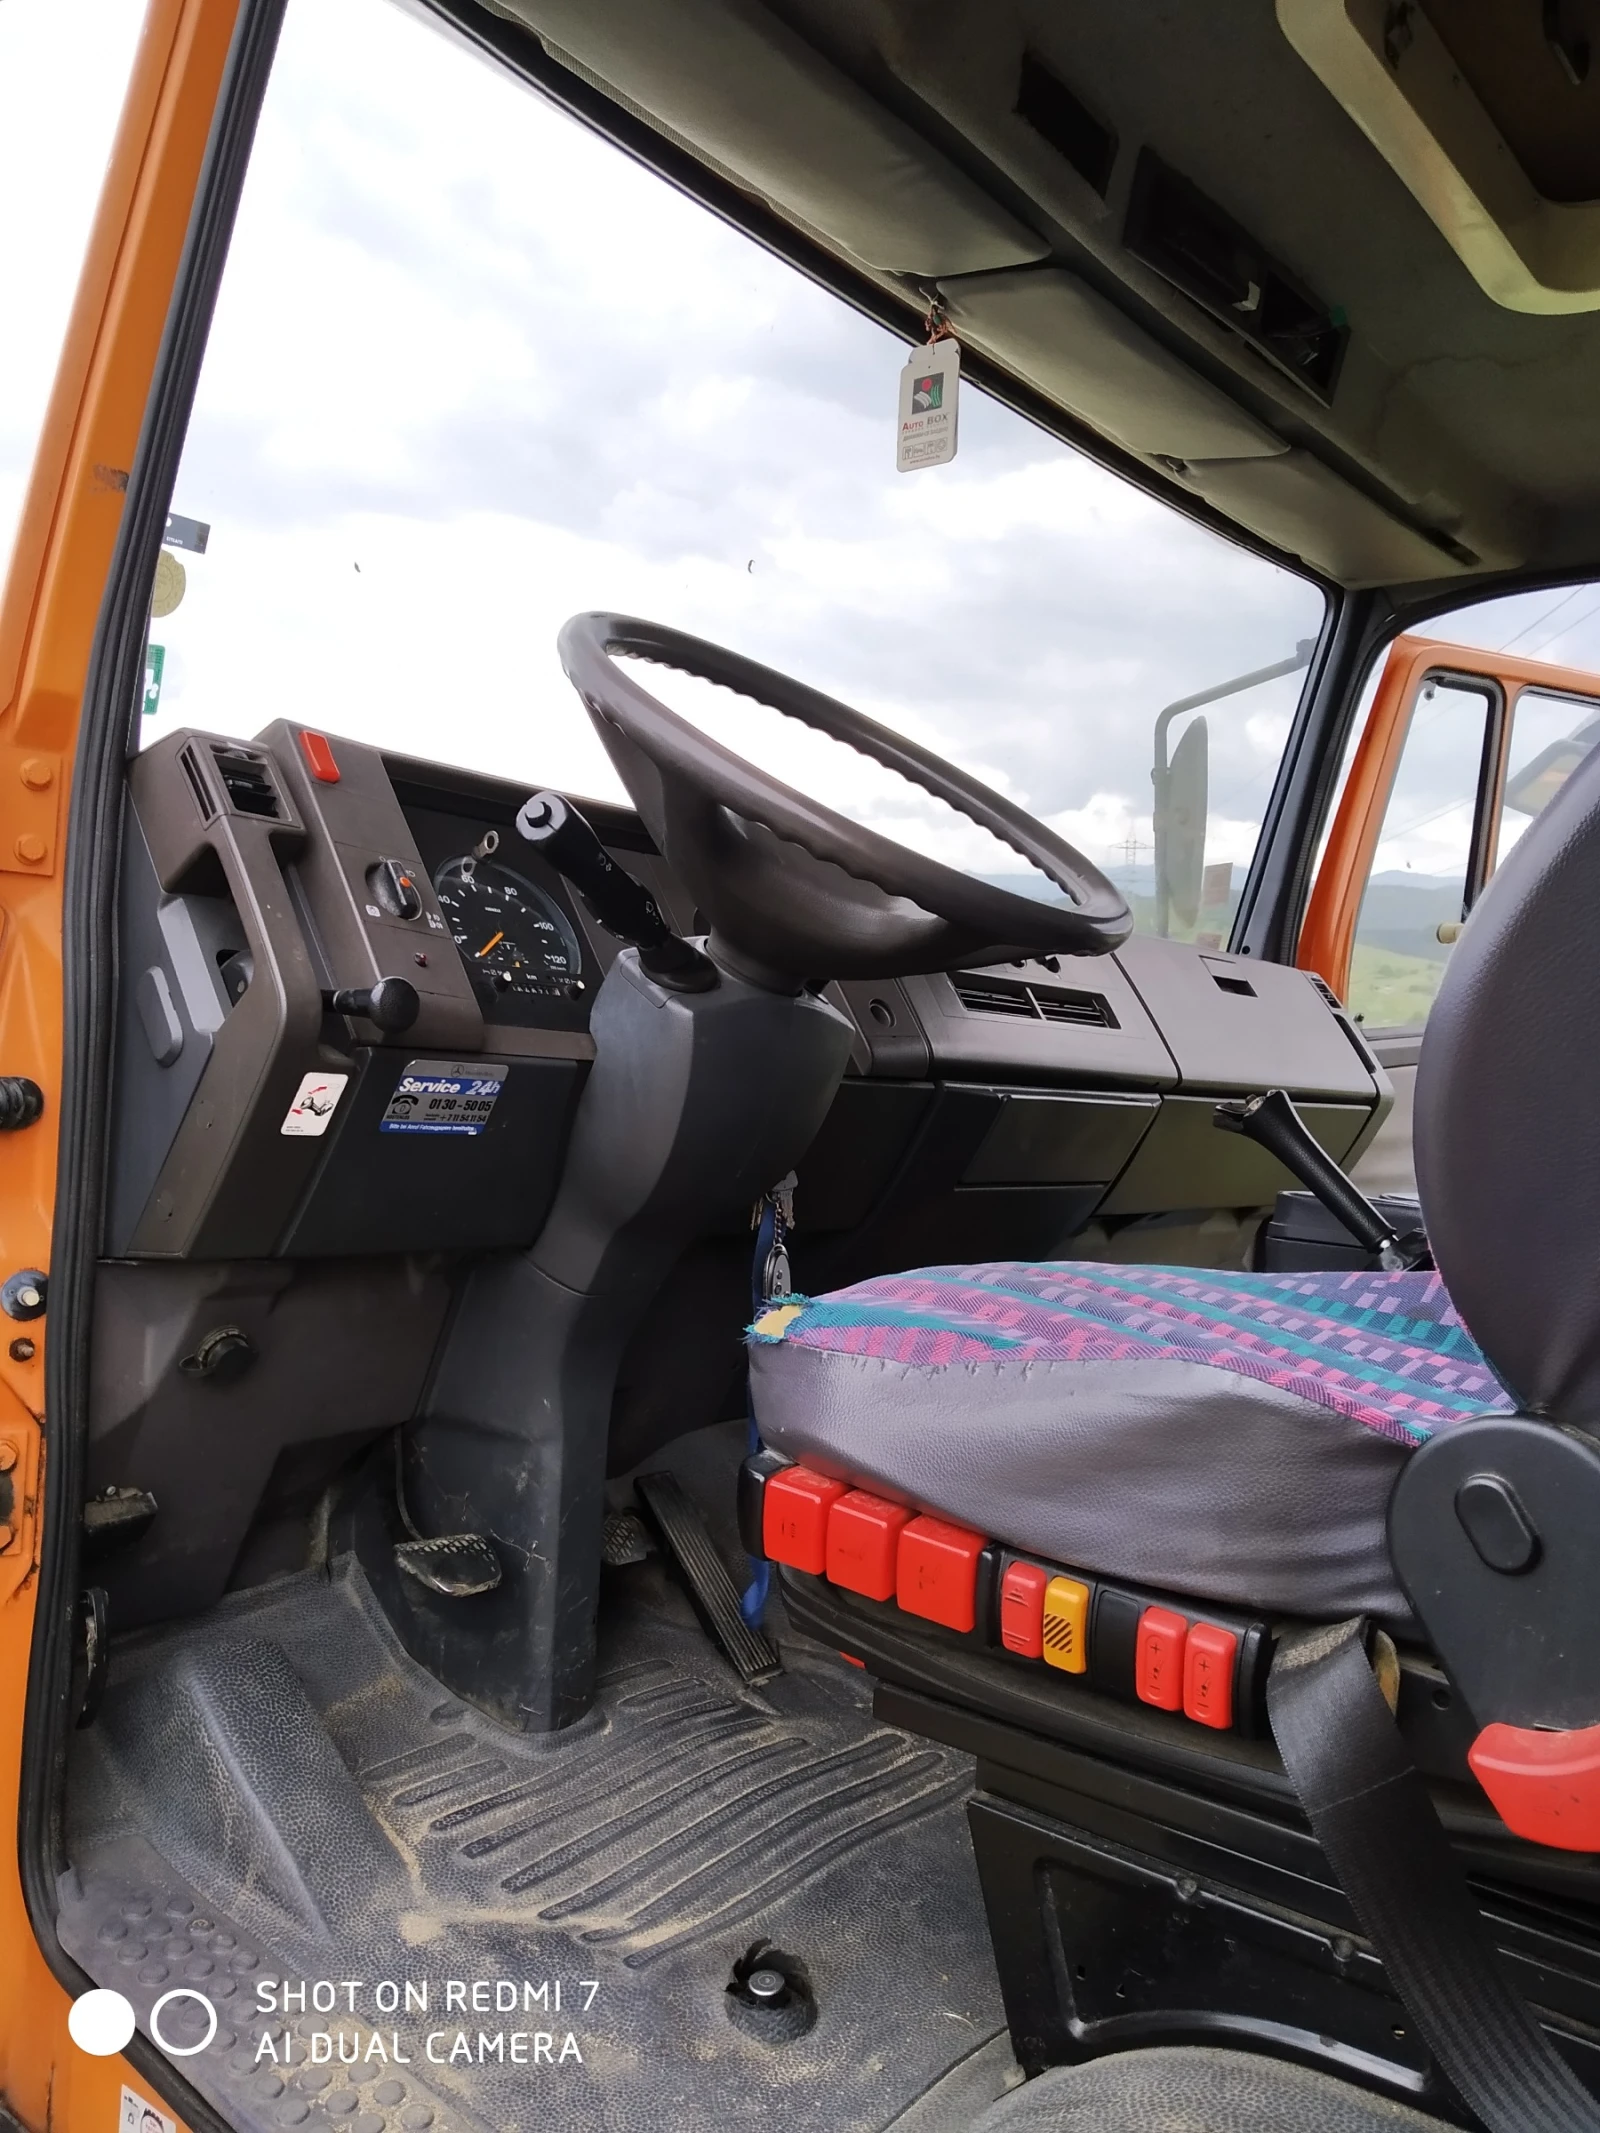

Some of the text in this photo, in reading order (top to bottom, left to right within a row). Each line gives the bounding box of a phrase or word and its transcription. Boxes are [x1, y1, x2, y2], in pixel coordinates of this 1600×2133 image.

[927, 413, 949, 425] BOX
[461, 874, 475, 884] 60
[504, 886, 518, 896] 80
[538, 921, 554, 931] 100
[454, 935, 462, 944] 0
[550, 955, 567, 965] 120
[526, 973, 538, 981] km
[399, 1077, 501, 1096] Service 24h
